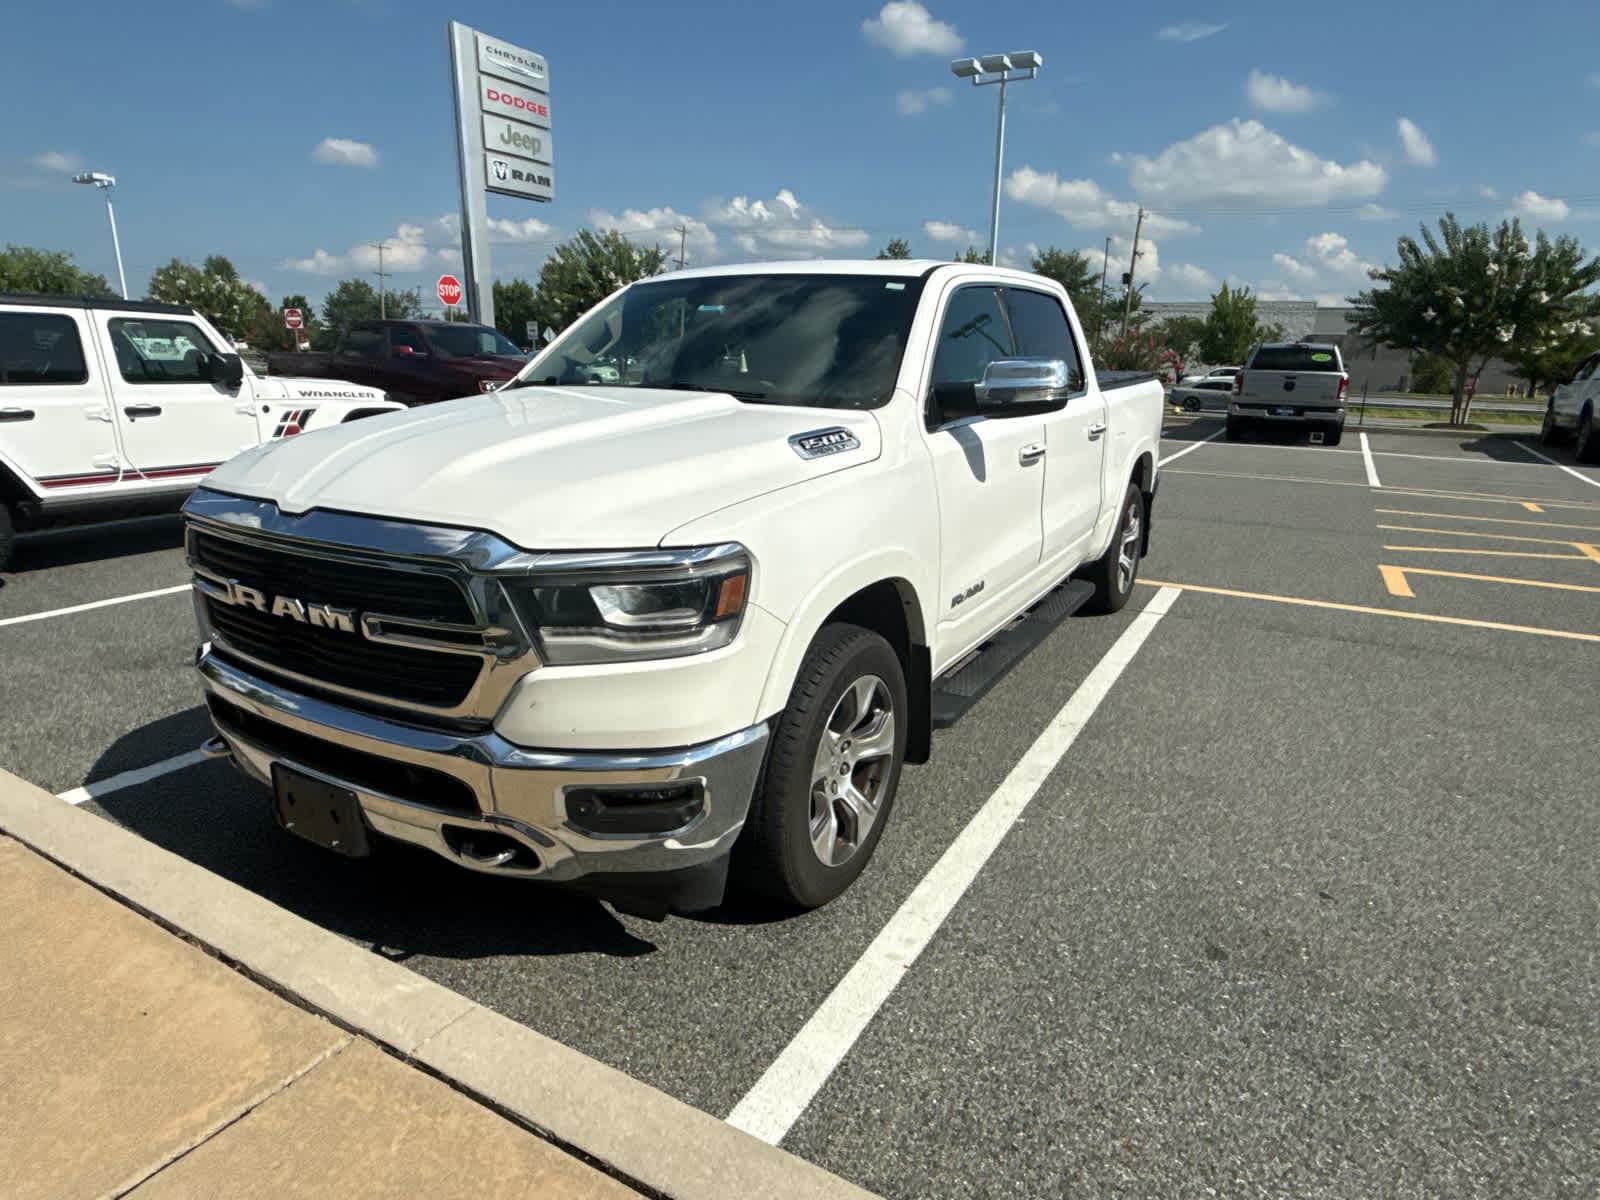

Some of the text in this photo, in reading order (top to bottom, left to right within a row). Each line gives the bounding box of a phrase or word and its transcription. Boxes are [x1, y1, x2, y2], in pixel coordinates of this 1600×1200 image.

[486, 46, 544, 72] CHRYSLER
[487, 89, 547, 117] DODGE
[500, 124, 542, 155] Jeep
[512, 169, 551, 187] RAM
[439, 284, 460, 296] STOP
[298, 390, 376, 399] WRANGLER
[232, 584, 355, 633] RAM
